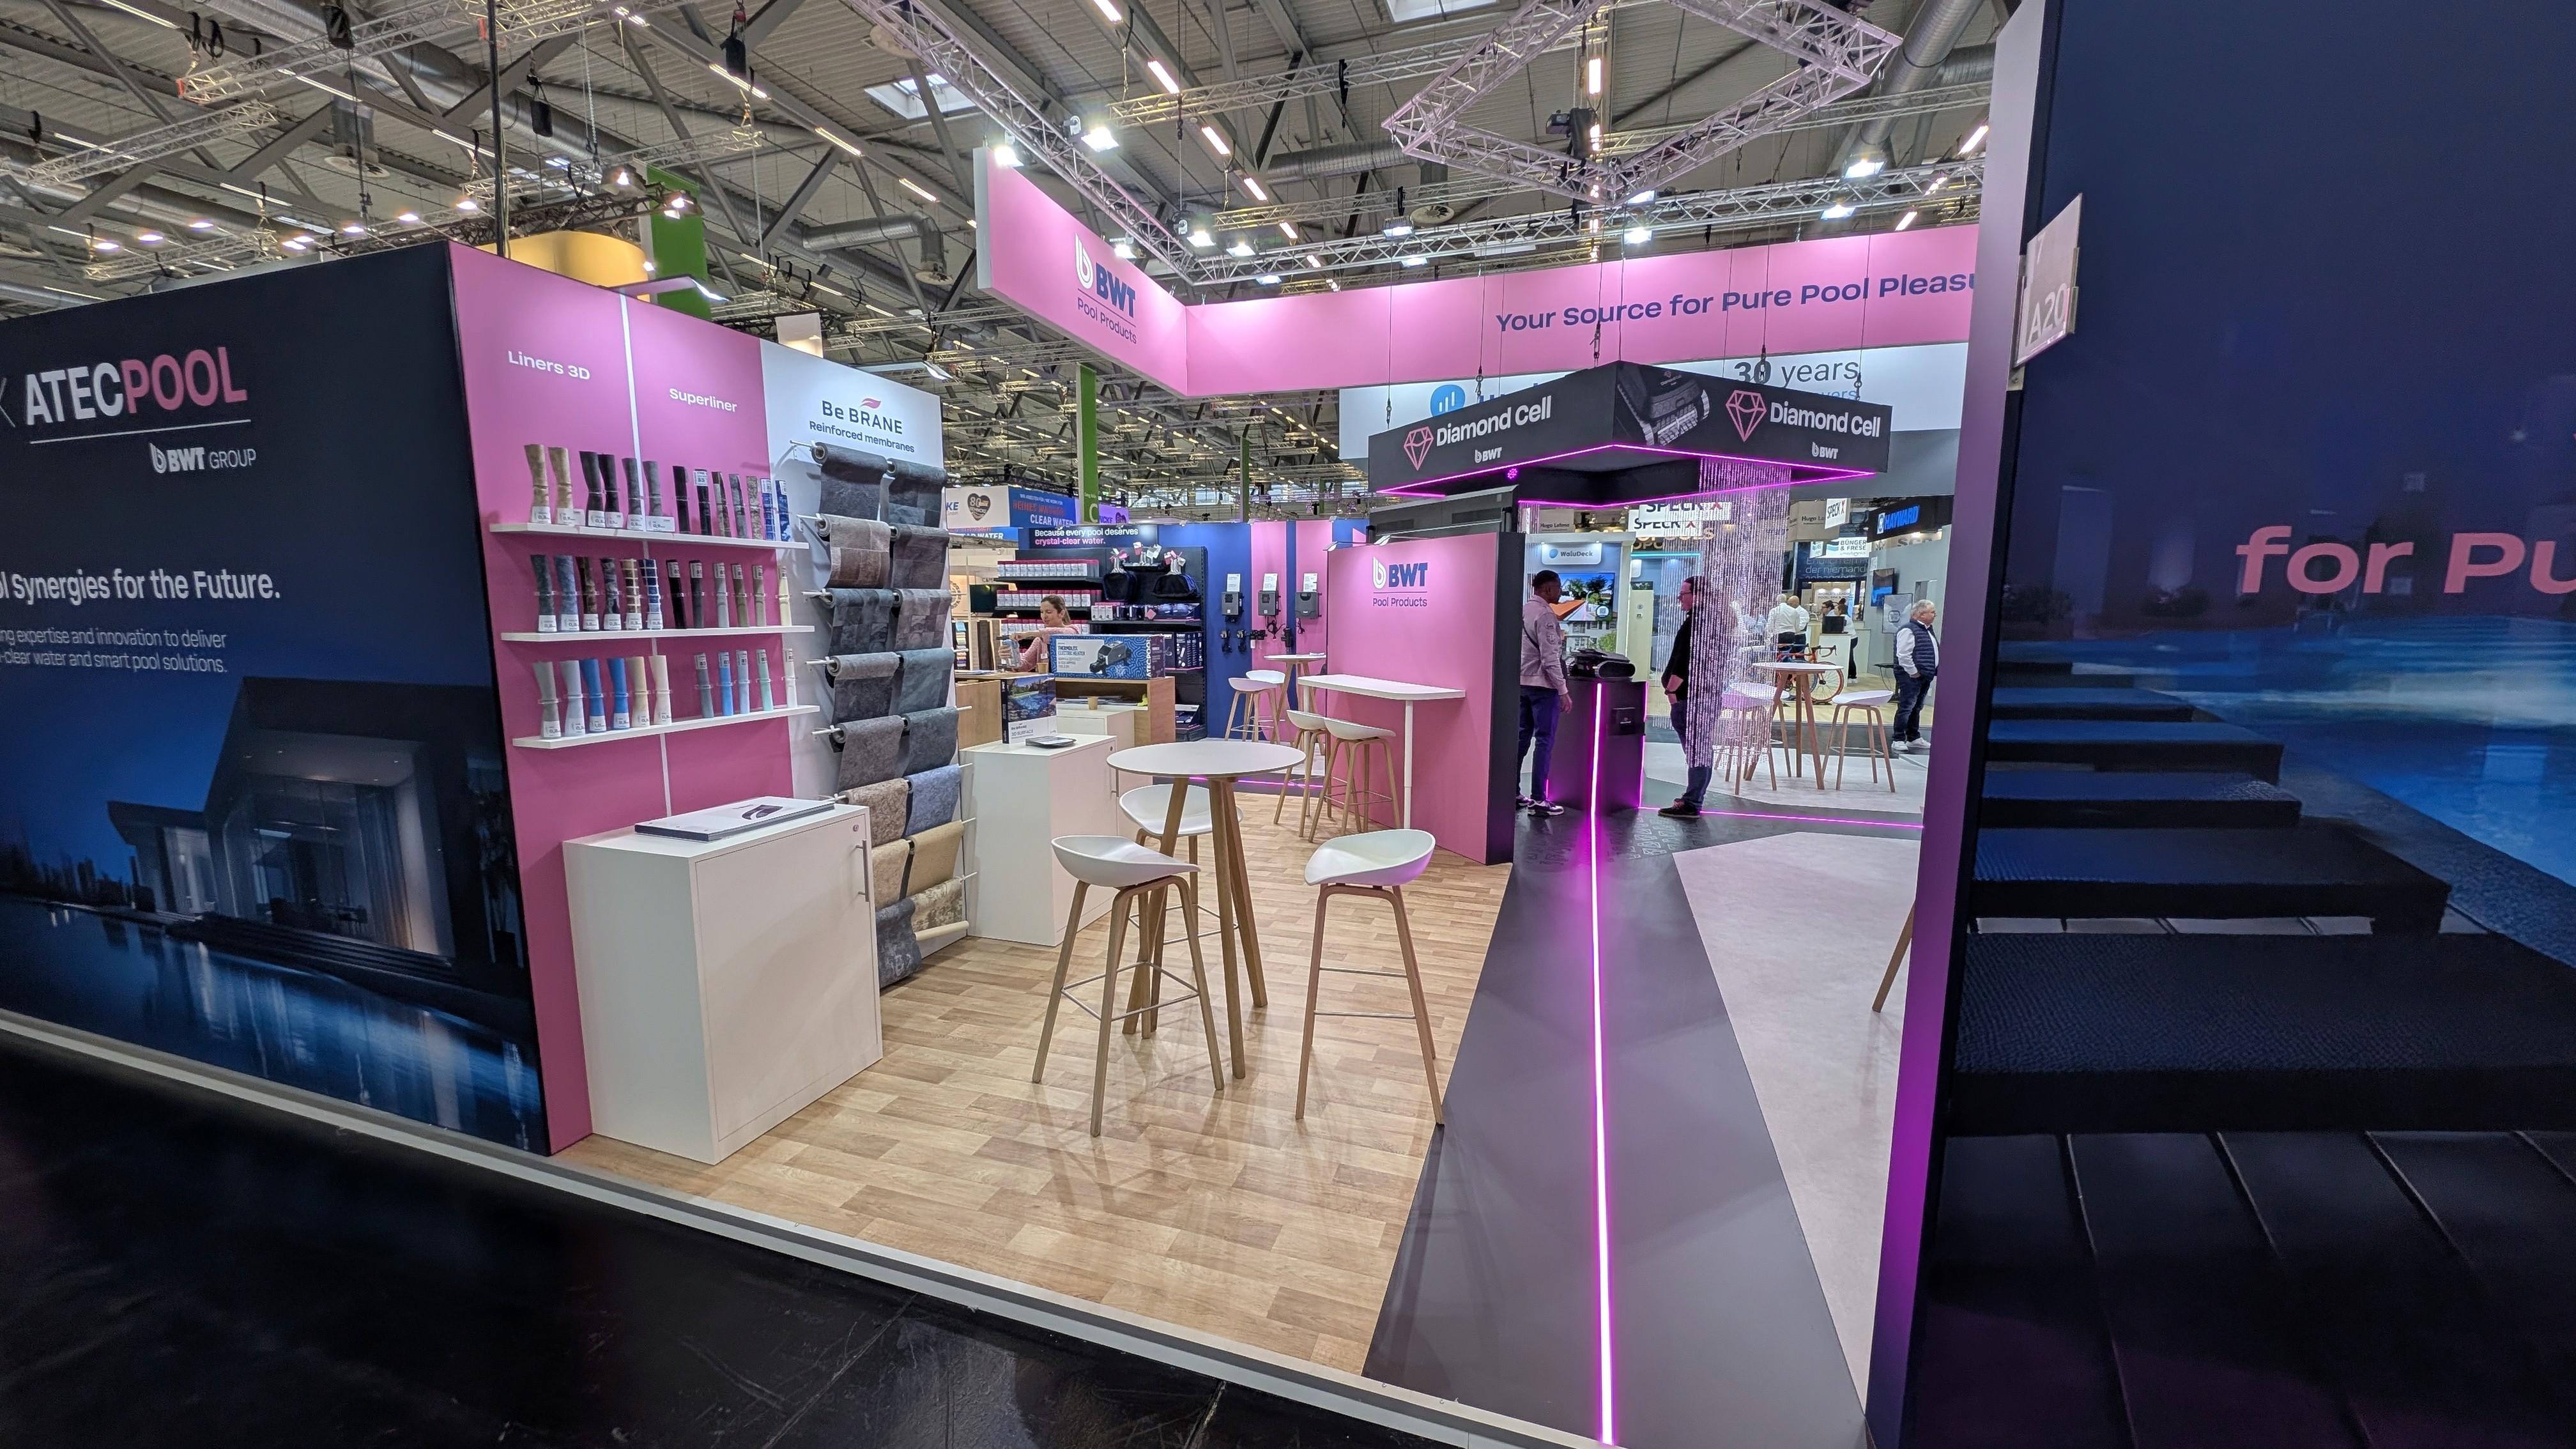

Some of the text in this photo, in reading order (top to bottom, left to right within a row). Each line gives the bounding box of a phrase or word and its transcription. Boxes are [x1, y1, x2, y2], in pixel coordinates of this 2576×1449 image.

[1095, 261, 1136, 318] BWT
[1496, 311, 1556, 332] Your
[1563, 302, 1661, 326] Source
[1670, 294, 1713, 316] for
[1722, 289, 1791, 311] Pure
[1800, 277, 1869, 305] Pool
[2027, 283, 2067, 346] A20
[1077, 296, 1137, 345] Pool Products
[508, 351, 590, 380] Liners 3D
[1734, 360, 1860, 388] 30 years
[25, 346, 249, 425] ATECPOOL
[670, 388, 737, 413] Superliner
[822, 400, 903, 435] Be BRANE
[1436, 395, 1552, 447] Diamond Cell
[1770, 401, 1881, 438] Diamond Cell
[809, 420, 915, 453] Reinforced membranes
[167, 447, 256, 473] BWT GROUP
[1482, 447, 1502, 463] BWT
[1819, 446, 1839, 460] BWT
[1030, 514, 1052, 526] CLEAR
[1884, 504, 1920, 530] HAYWARD
[1035, 537, 1080, 547] crystal-clear
[1066, 530, 1085, 539] every
[1087, 528, 1103, 538] pool
[1105, 526, 1138, 535] deserves
[1805, 564, 1866, 574] der niemand
[2235, 525, 2576, 594] for Pu
[12, 568, 111, 606] Synergies
[113, 568, 146, 599] for
[150, 568, 190, 599] the
[194, 569, 281, 599] Future.
[1388, 562, 1429, 588] BWT
[1372, 597, 1428, 608] Pool Products
[16, 627, 70, 647] expertise
[71, 627, 95, 645] and
[96, 627, 162, 647] innovation
[164, 629, 180, 647] to
[181, 629, 227, 648] deliver
[33, 650, 66, 666] water
[68, 650, 93, 667] and
[93, 652, 131, 669] smart
[132, 652, 160, 673] pool
[162, 652, 228, 673] solutions.
